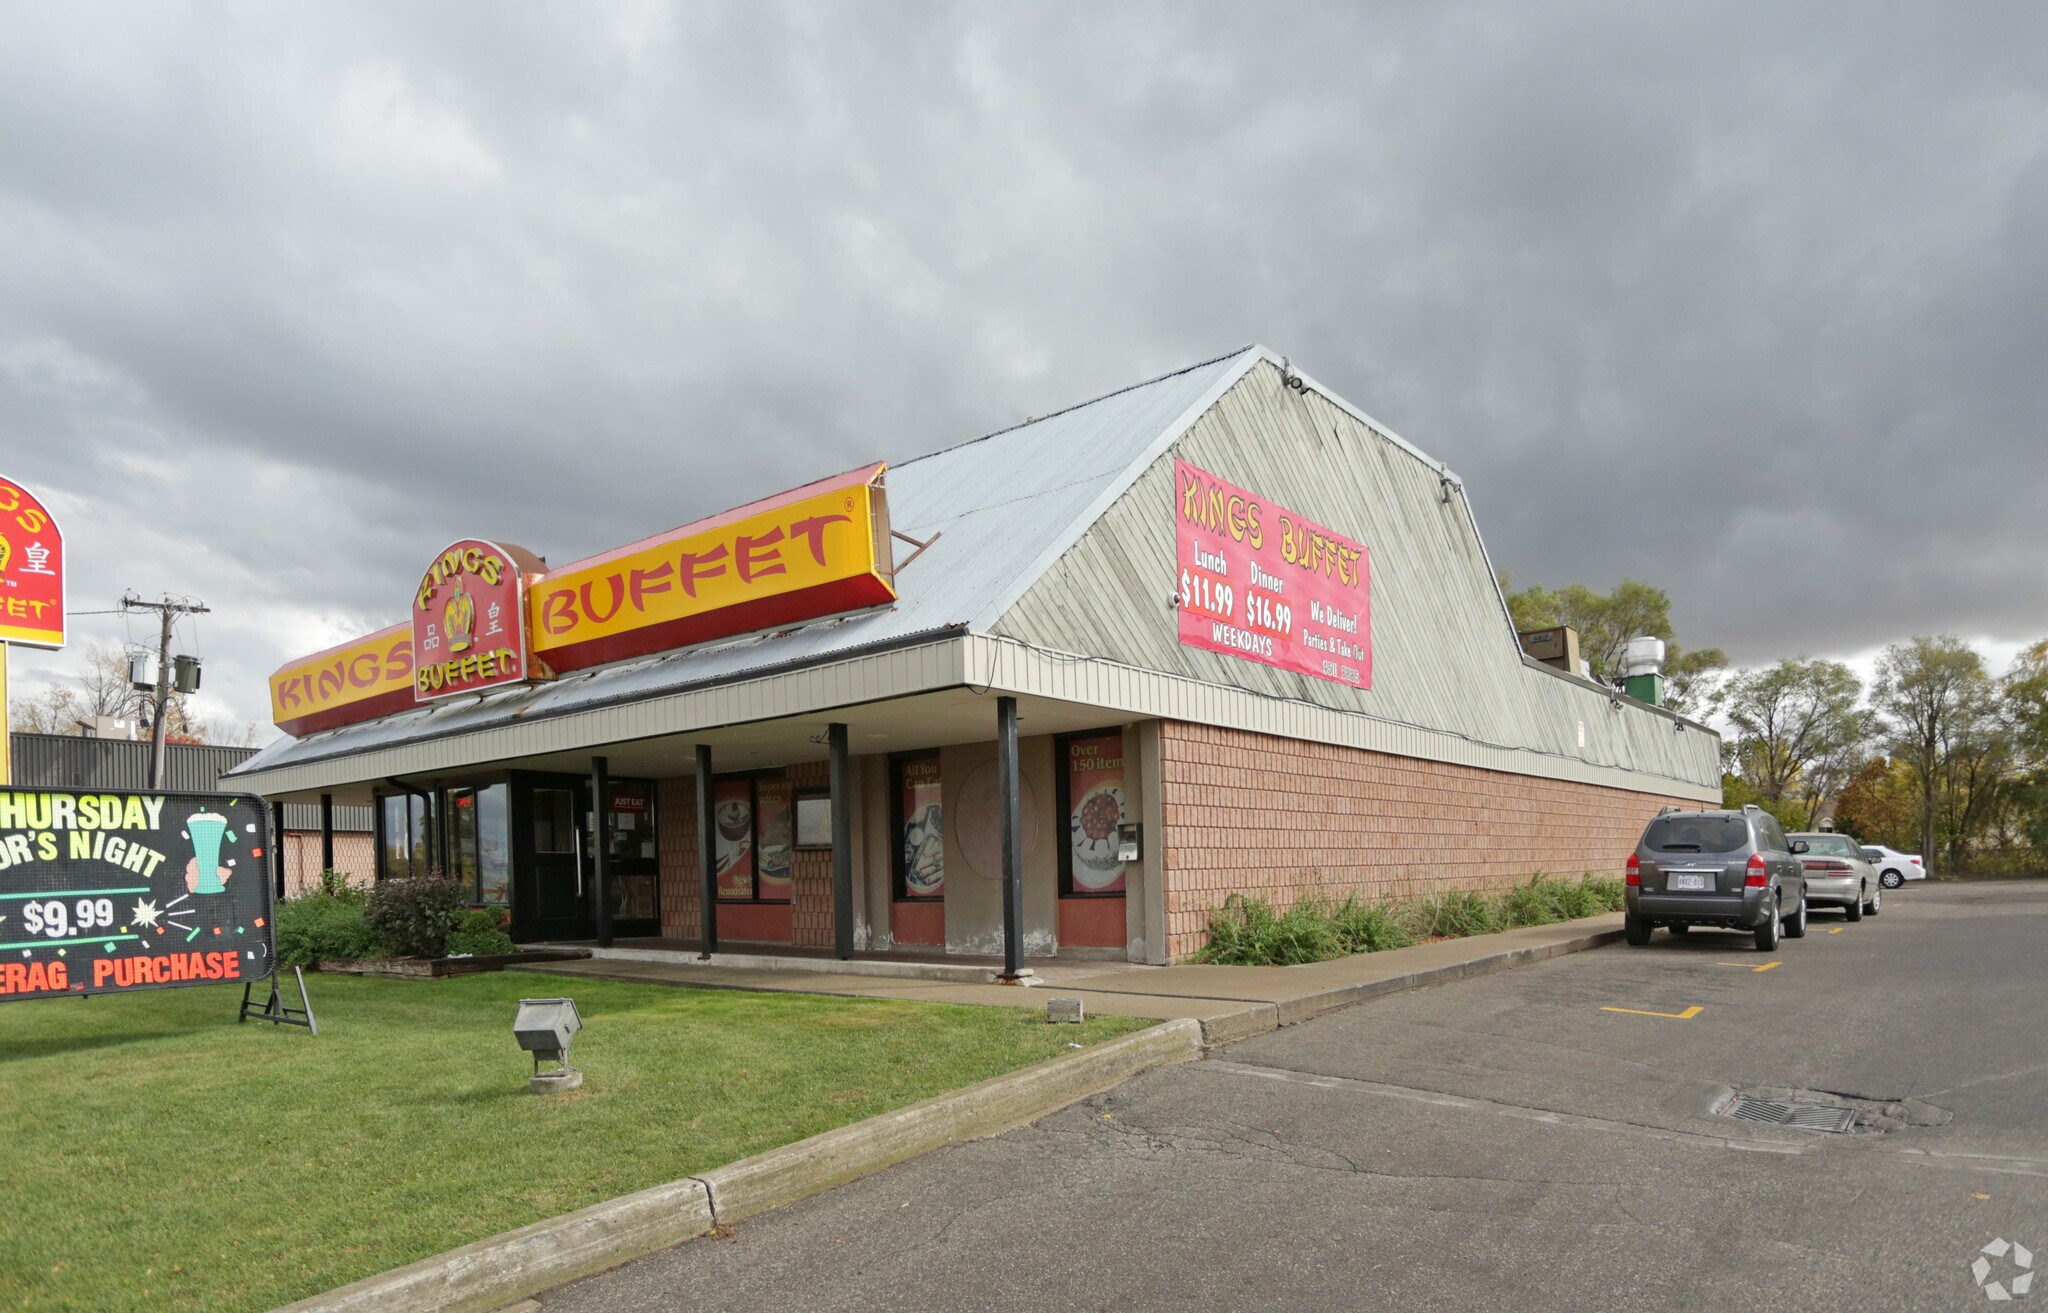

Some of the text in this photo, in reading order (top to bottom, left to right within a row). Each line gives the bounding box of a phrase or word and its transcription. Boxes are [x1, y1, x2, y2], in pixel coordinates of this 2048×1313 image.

[1182, 469, 1361, 589] KINGS BUFFET
[18, 541, 55, 575] 皇
[542, 514, 852, 635] BUFFET
[1194, 538, 1227, 577] Lunch
[418, 548, 504, 610] KINGS
[1181, 567, 1233, 617] $11.99
[1250, 560, 1284, 594] Dinner
[0, 596, 51, 620] ET
[485, 601, 503, 636] 皇
[1246, 590, 1291, 635] $16.99
[1310, 599, 1357, 635] We Deliver!
[423, 623, 440, 651] 品
[1212, 621, 1272, 657] WEEKDAYS
[1303, 627, 1328, 652] Parties
[1329, 636, 1336, 653] &
[1336, 638, 1351, 658] Take
[278, 641, 414, 711] KINGS
[417, 648, 516, 692] BUFFET
[1072, 744, 1099, 757] Over
[1072, 758, 1094, 772] 150
[905, 763, 937, 776] All You
[614, 798, 644, 807] JUST EAT
[758, 781, 780, 795] Super
[69, 830, 166, 878] NIGHT
[23, 898, 114, 938] $9.99
[93, 951, 241, 988] PURCHASE
